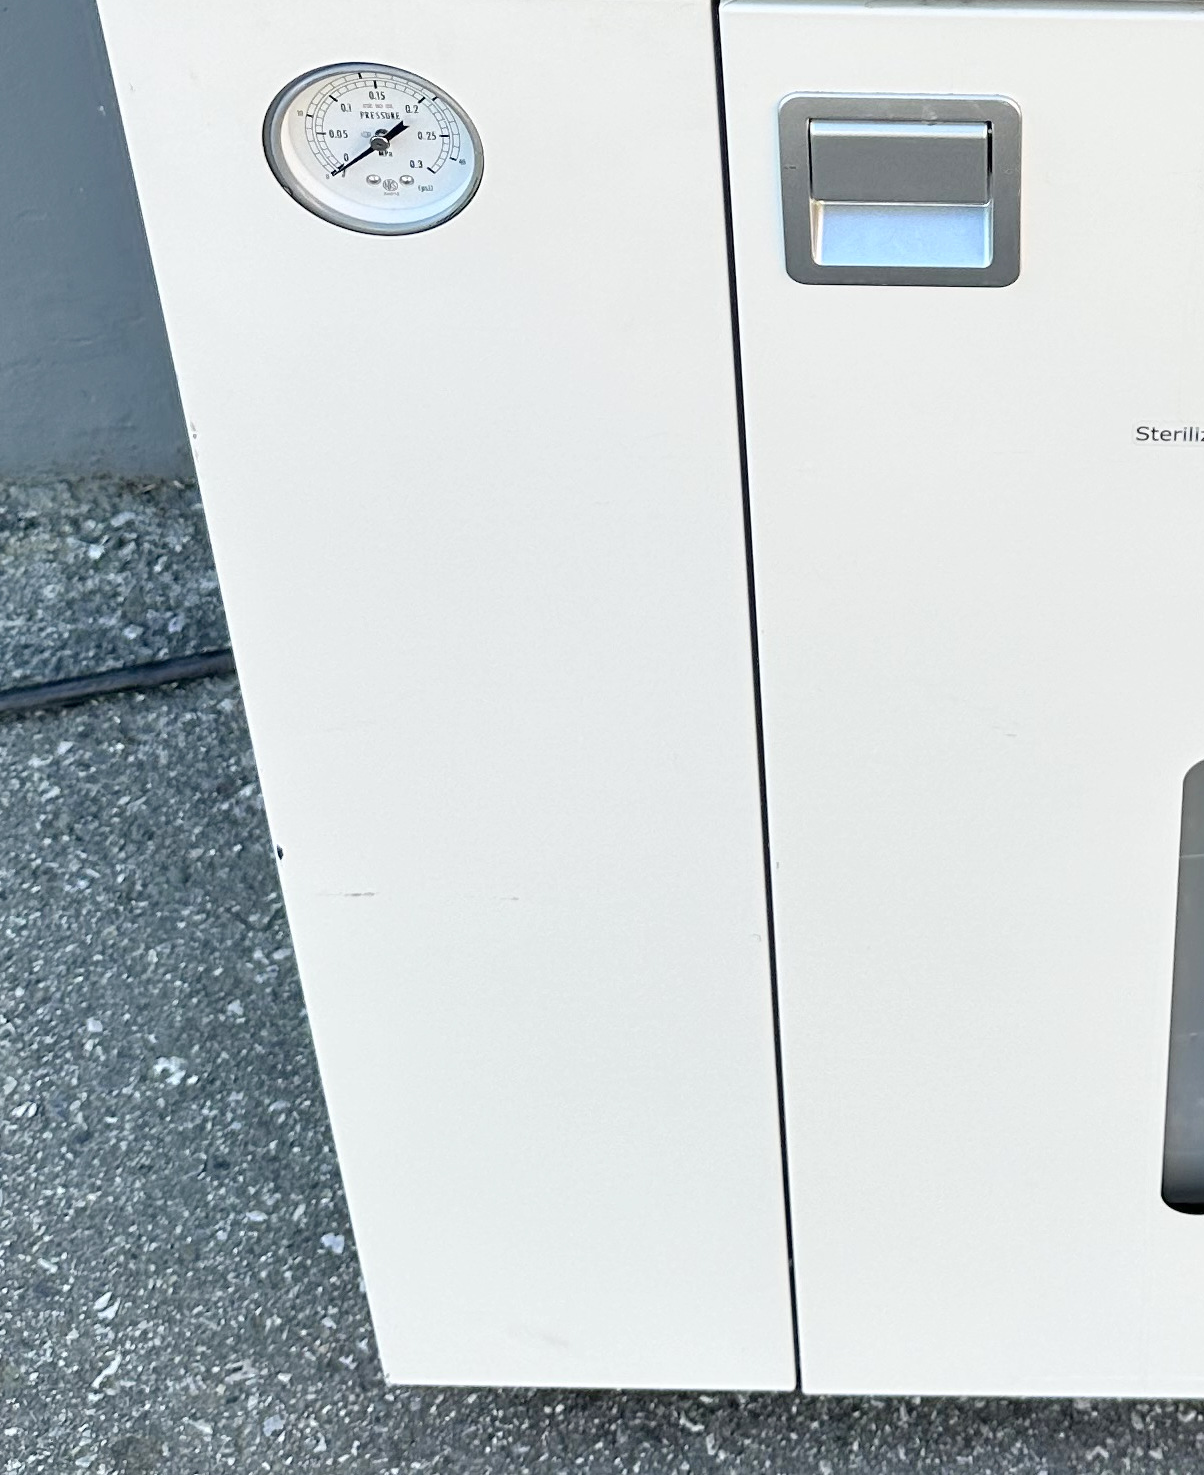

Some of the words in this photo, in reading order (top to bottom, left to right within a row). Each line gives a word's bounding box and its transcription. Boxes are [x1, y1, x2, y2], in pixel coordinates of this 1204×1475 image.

[369, 91, 385, 100] 0.15
[341, 103, 352, 112] 0.1
[405, 105, 419, 114] 0.2
[360, 111, 400, 120] PRESSURE
[329, 130, 348, 139] 0.05
[418, 131, 437, 140] 0.25
[344, 154, 349, 162] 0
[410, 160, 423, 169] 0.3
